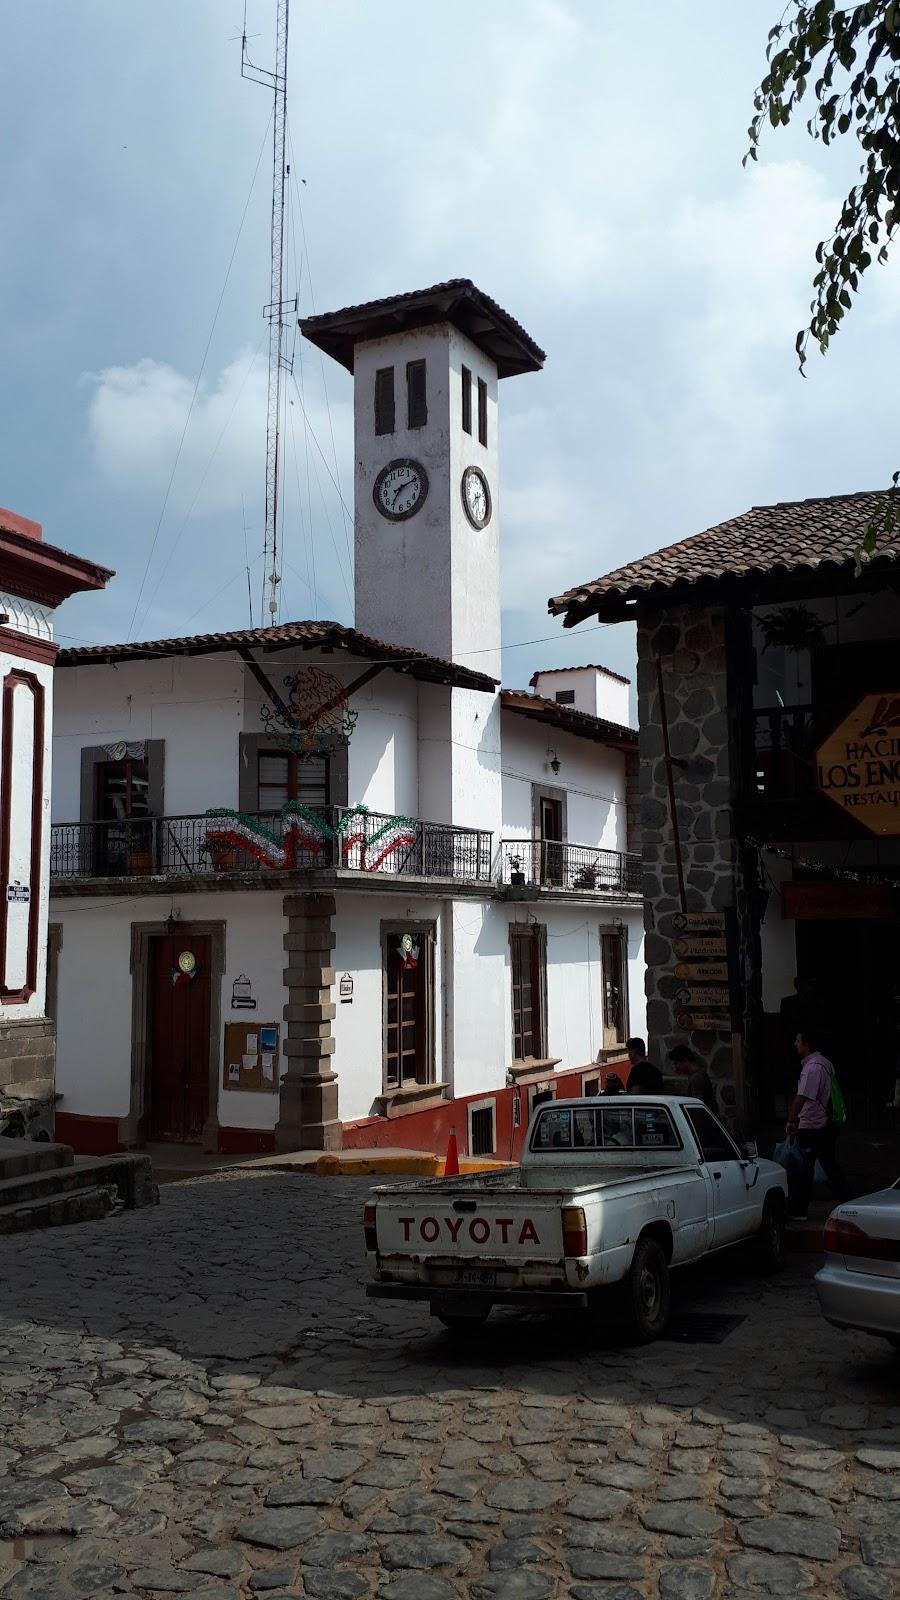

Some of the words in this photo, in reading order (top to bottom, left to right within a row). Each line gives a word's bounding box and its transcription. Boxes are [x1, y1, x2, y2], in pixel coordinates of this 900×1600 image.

[390, 472, 396, 480] 11
[397, 469, 405, 477] 12
[384, 480, 391, 489] 10
[414, 483, 419, 491] 3
[383, 489, 388, 497] 9
[385, 498, 391, 506] 8
[407, 500, 412, 508] 5
[398, 504, 404, 512] 6
[818, 763, 861, 788] LOS
[398, 1216, 541, 1245] TOYOTA
